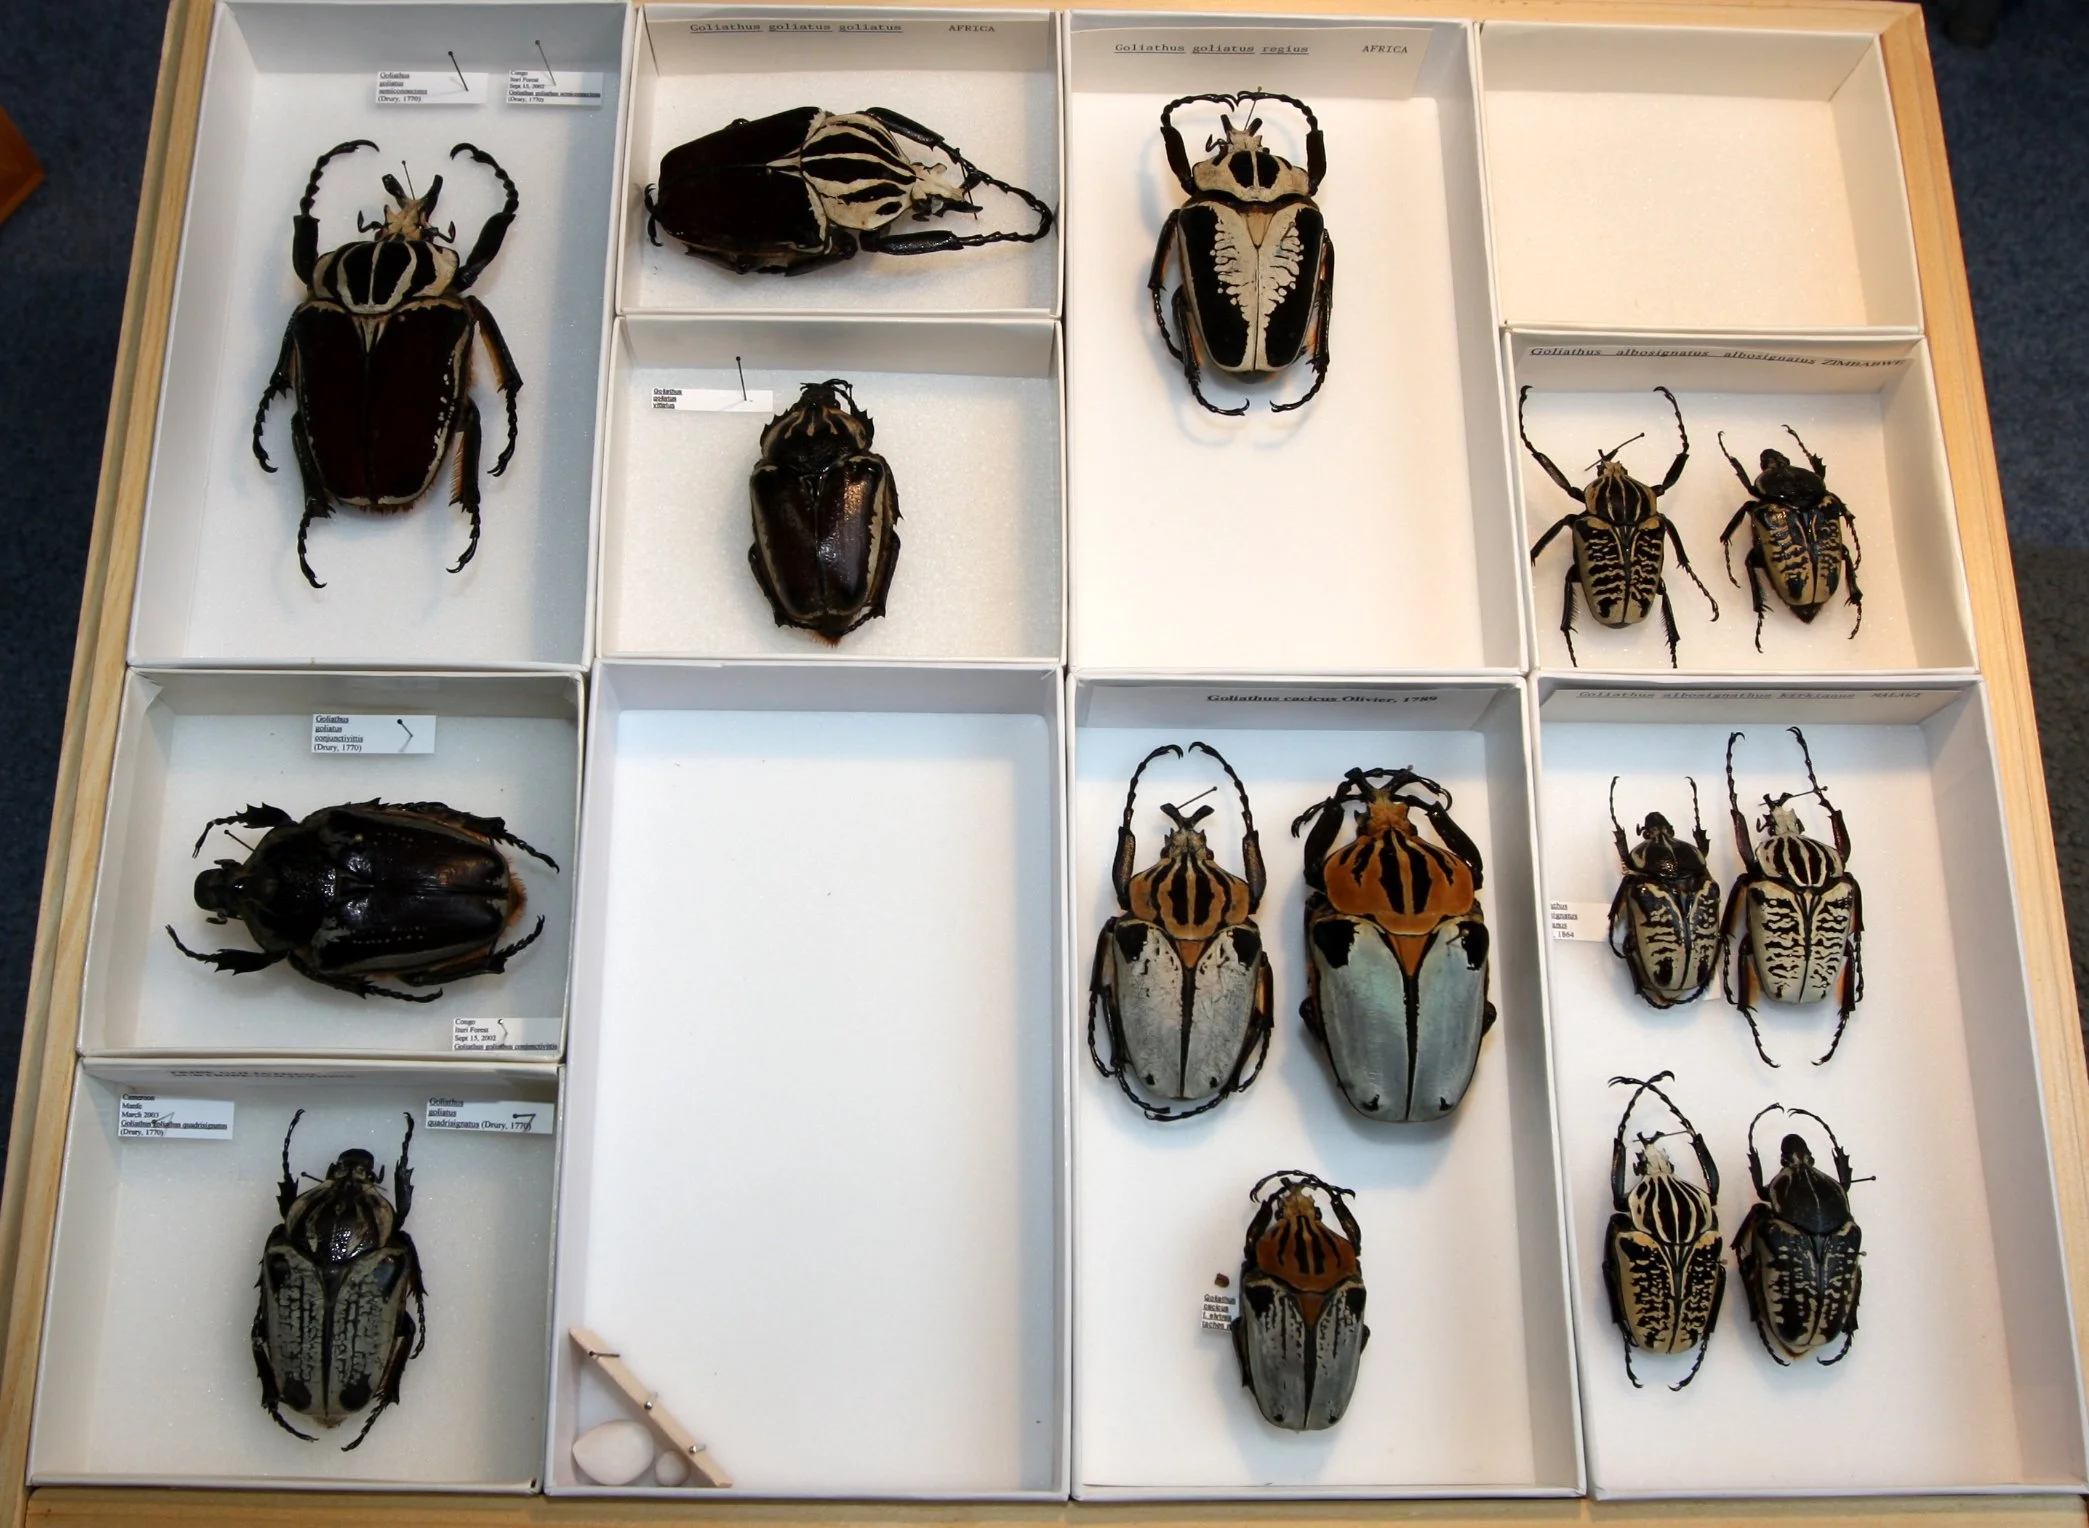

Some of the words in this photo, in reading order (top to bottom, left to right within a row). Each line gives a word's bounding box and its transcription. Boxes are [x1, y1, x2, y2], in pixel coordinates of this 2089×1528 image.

[690, 22, 763, 33] Goliathus
[768, 23, 832, 33] goliatus
[839, 23, 903, 33] goliatus
[948, 25, 996, 33] AFRICA
[1113, 43, 1186, 54] Goliathus
[1191, 45, 1255, 54] goliatus
[1260, 46, 1309, 55] regius
[1362, 45, 1409, 53] AFRICA
[1530, 347, 1602, 357] Goliathus
[1616, 348, 1710, 357] albosignatus
[1723, 350, 1816, 365] albosignatus
[1284, 695, 1338, 703] cacicus
[1342, 695, 1398, 704] Olivier,
[315, 715, 349, 724] Goliathus
[315, 724, 342, 733] goliatus
[313, 743, 340, 752] (Drury,
[342, 744, 362, 752] 1770)
[429, 1098, 464, 1107] Goliathus
[428, 1108, 457, 1117] goliatus
[481, 1120, 508, 1130] (Drury,
[511, 1122, 532, 1131] 1770)
